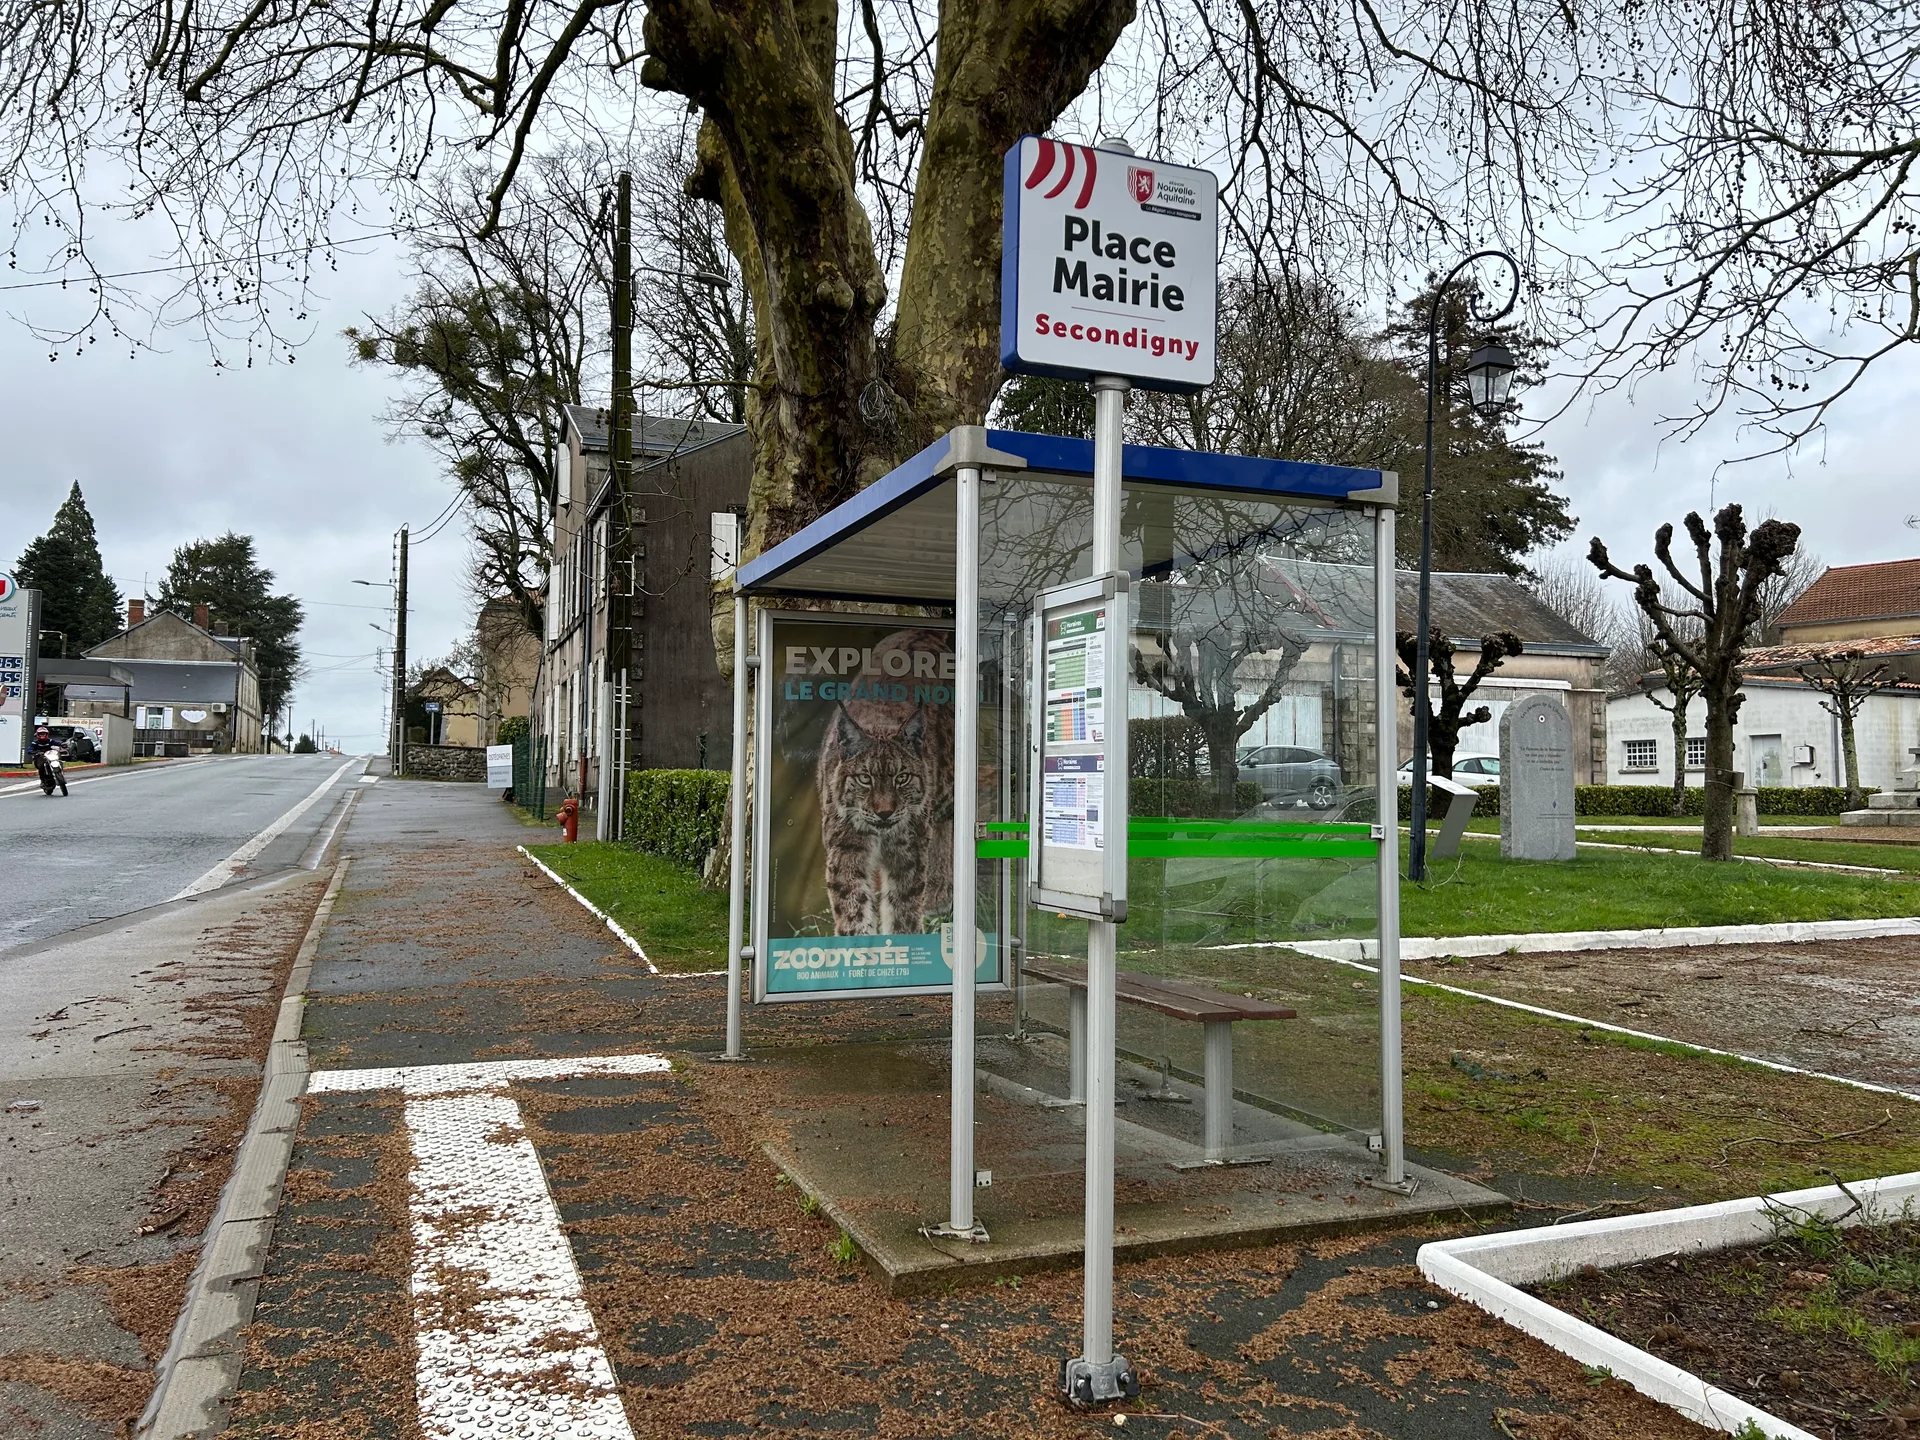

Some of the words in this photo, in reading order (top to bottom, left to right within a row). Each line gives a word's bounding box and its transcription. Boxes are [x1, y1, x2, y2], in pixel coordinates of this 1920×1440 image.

[1157, 182, 1196, 196] Nouvelle-
[1157, 192, 1196, 206] Aquitaine
[1064, 215, 1176, 268] Place
[1053, 256, 1185, 312] Mairie
[1035, 313, 1200, 362] Secondigny
[785, 646, 983, 680] EXPLORE
[785, 681, 814, 700] LE
[818, 681, 908, 702] GRAND
[914, 684, 984, 704] NO
[773, 939, 910, 970] ZOODYSSÉE
[796, 972, 809, 980] 800
[810, 970, 839, 979] ANIMAUX
[848, 968, 867, 978] FORÊT
[868, 969, 876, 977] DE
[877, 967, 895, 976] CHIZÉ
